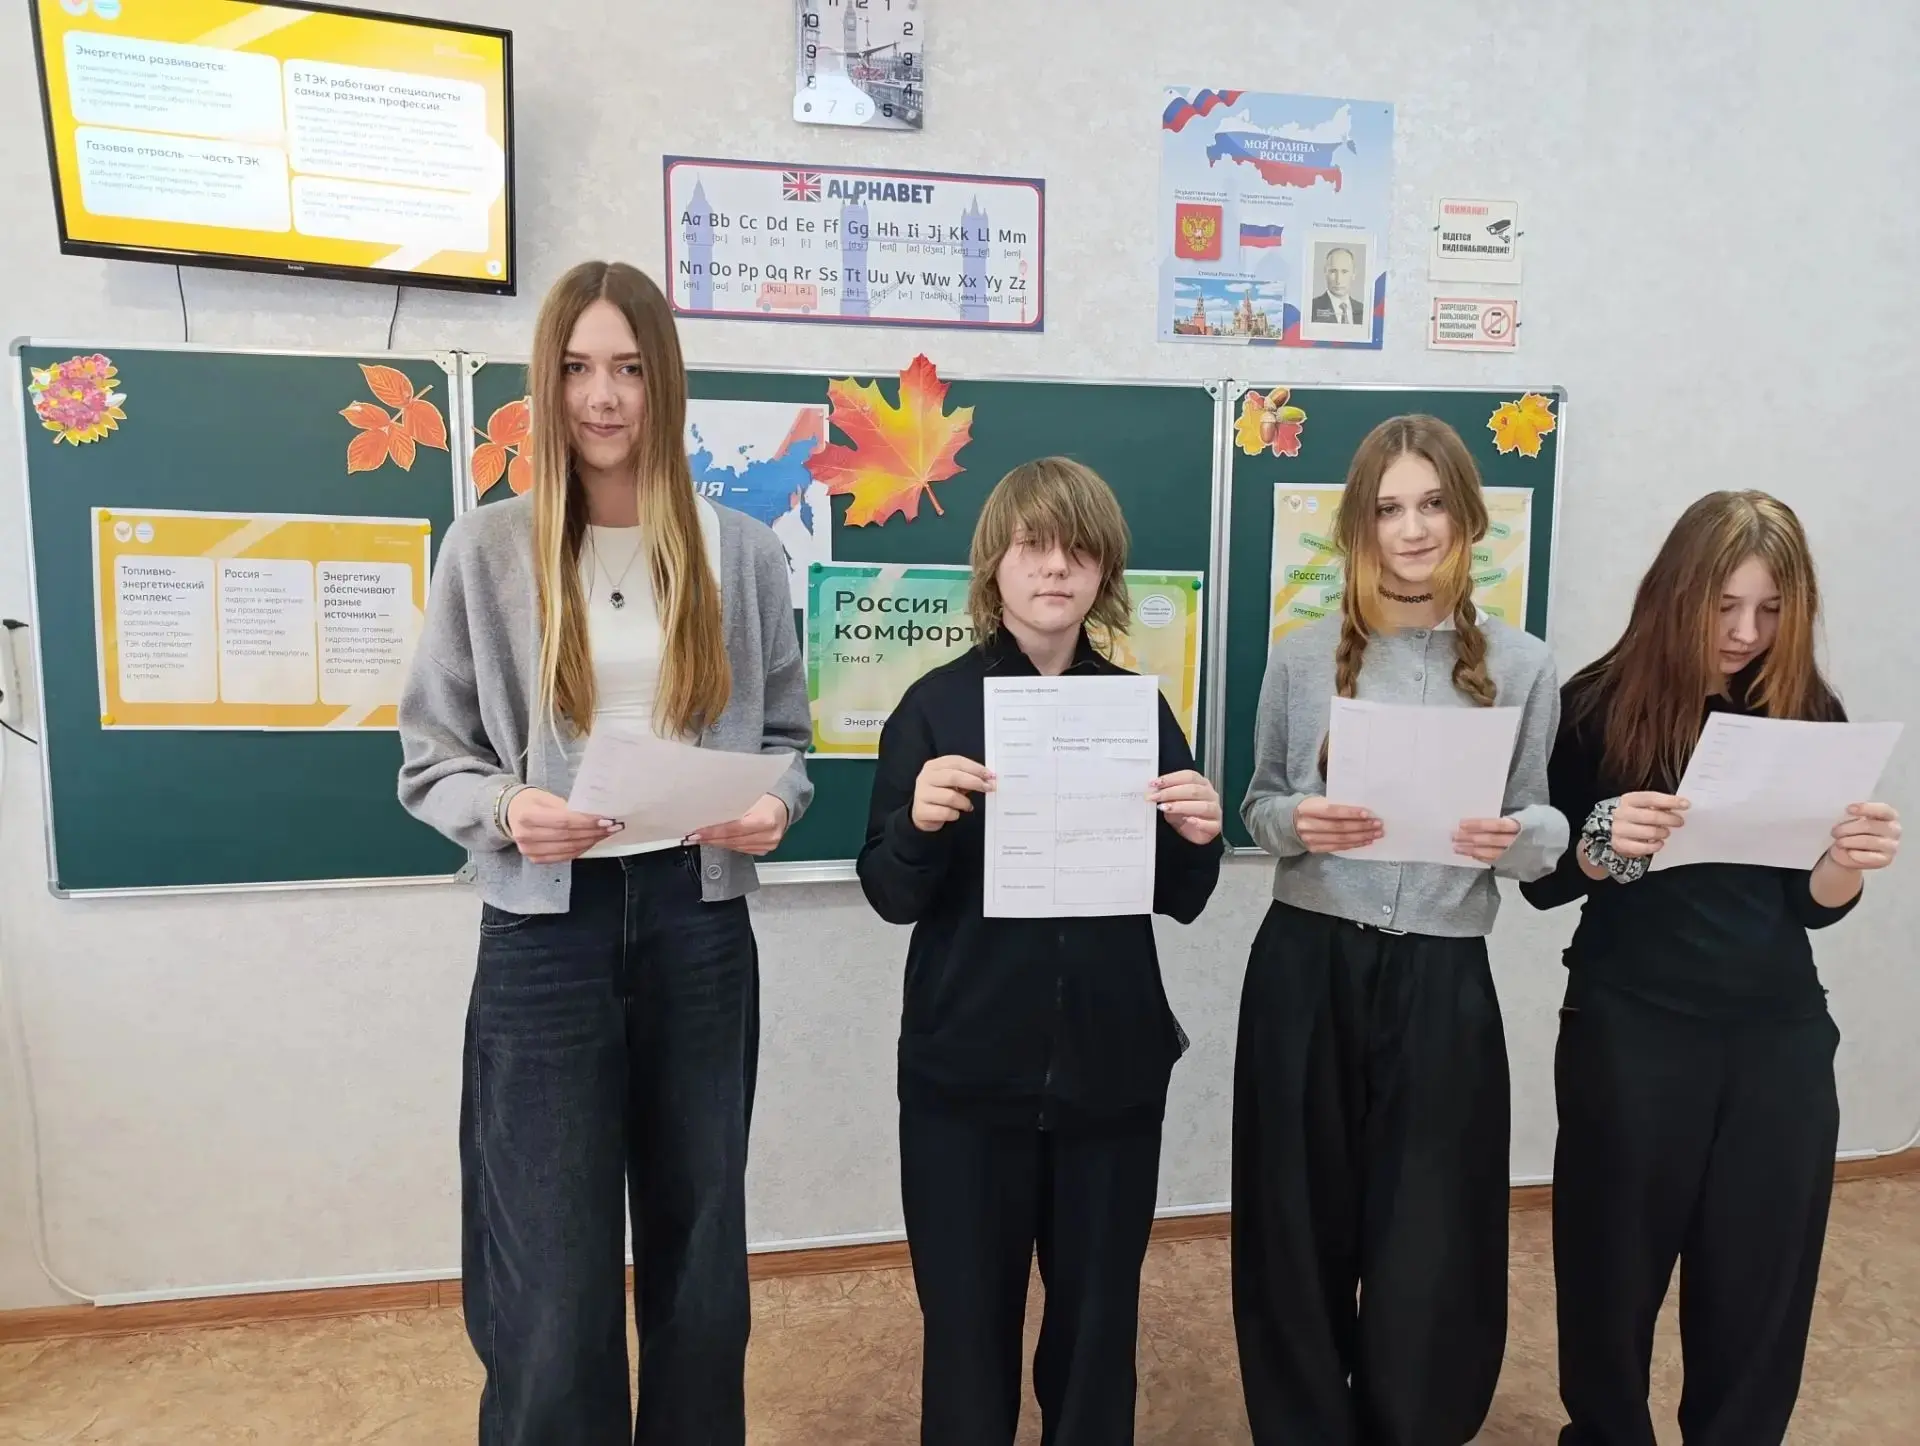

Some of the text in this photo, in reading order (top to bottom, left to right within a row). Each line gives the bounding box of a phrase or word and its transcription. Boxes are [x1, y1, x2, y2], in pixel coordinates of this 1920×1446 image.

[802, 13, 819, 28] 10
[903, 21, 913, 36] 2
[76, 44, 146, 62] Энергетика
[806, 44, 817, 59] 9
[903, 52, 913, 66] 3
[294, 72, 461, 102] В ТЭК работают специалисты
[903, 83, 913, 97] 4
[294, 87, 330, 98] самых
[334, 92, 376, 103] разных
[828, 99, 838, 114] 7
[855, 102, 865, 115] 6
[883, 103, 893, 118] 5
[1244, 139, 1315, 153] МОЯ РОДИНА
[86, 140, 134, 153] Газовая
[137, 147, 184, 159] отрасль
[202, 153, 233, 164] часть
[237, 155, 260, 167] ТЭК
[1260, 151, 1304, 163] РОССИЯ
[827, 179, 935, 204] ALPHABET
[681, 211, 701, 226] Aa
[709, 213, 730, 228] Bb
[739, 215, 758, 229] Cc
[766, 216, 788, 231] Dd
[796, 218, 815, 232] Ee
[824, 219, 839, 233] Ff
[848, 220, 869, 239] Gg
[877, 222, 899, 237] Hh
[928, 225, 941, 242] Jj
[950, 226, 969, 241] Kk
[999, 229, 1027, 244] Mm
[1442, 232, 1471, 243] ВЕДЕТСЯ
[1442, 243, 1510, 254] ВИДЕОНАБЛЮДЕНИЕ!
[680, 260, 1026, 292] Nn Oo Pp Qq Rr Ss Tt Uu Vv Ww Xx Yy Zz
[121, 565, 176, 576] Топливно-
[224, 568, 260, 579] Россия
[323, 571, 381, 584] Энергетику
[1288, 569, 1336, 581] «Россети»
[122, 580, 205, 591] энергетический
[323, 584, 396, 595] обеспечивают
[122, 593, 173, 602] комплекс
[324, 599, 362, 608] разные
[835, 590, 948, 614] Россия
[324, 611, 377, 619] источники
[833, 653, 884, 664] Тема 7
